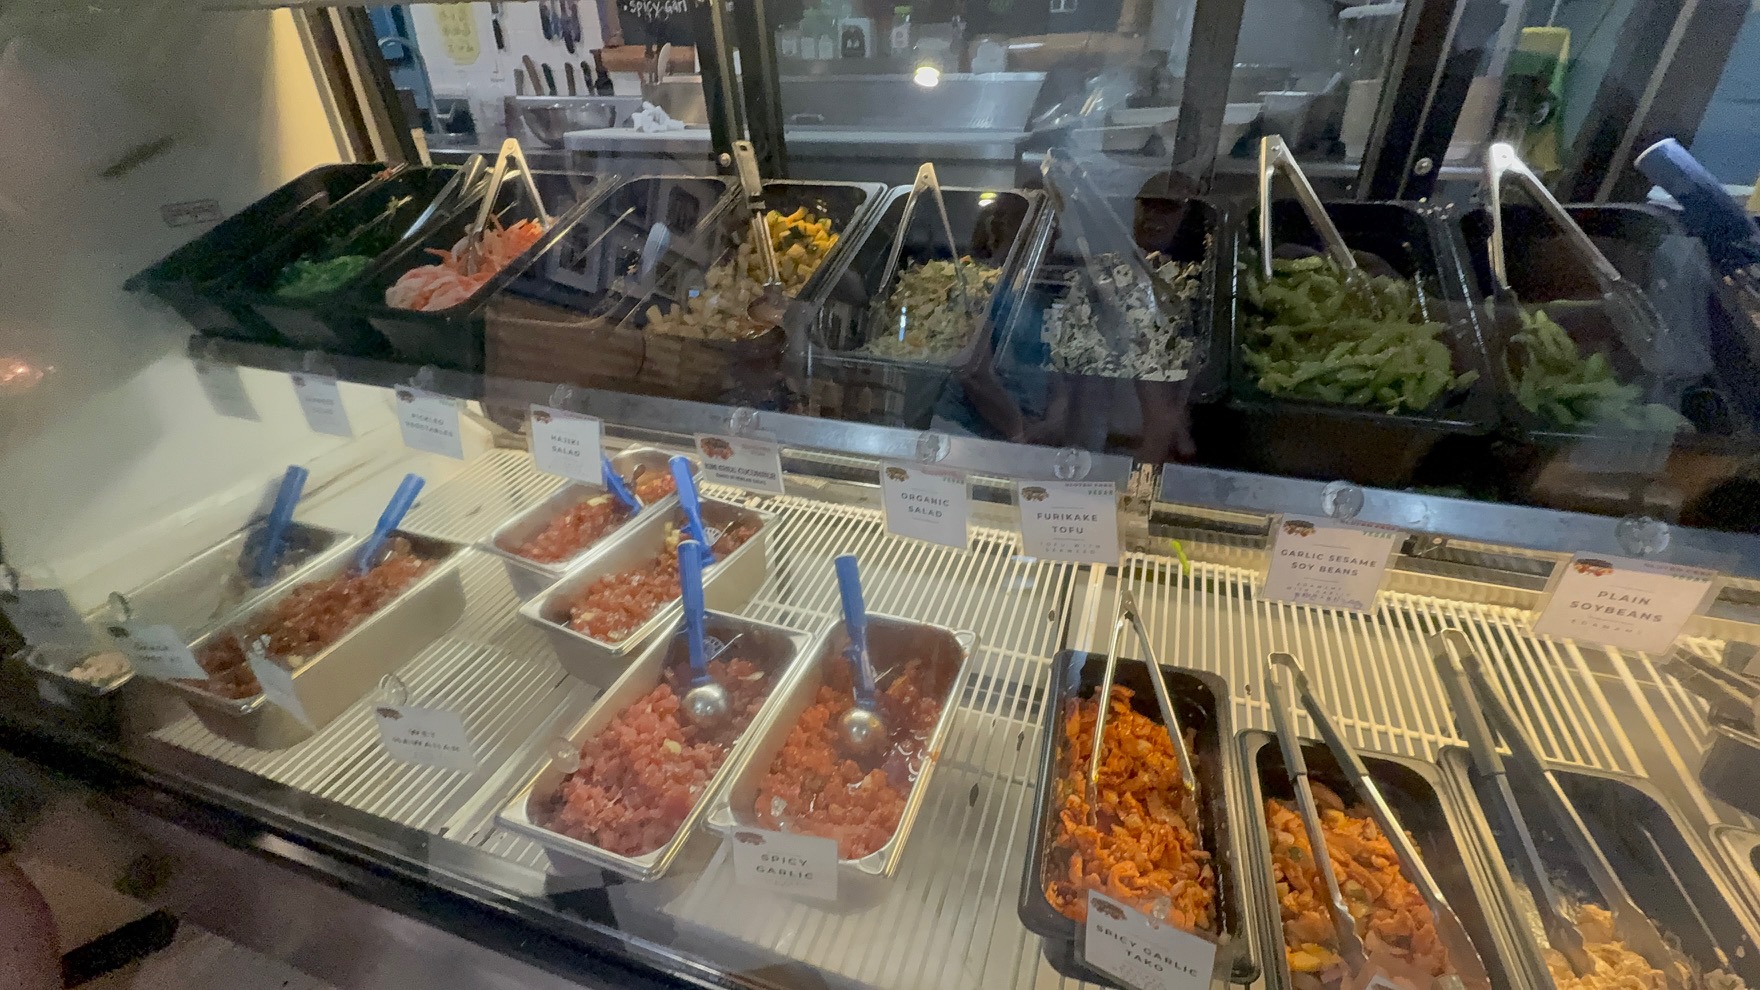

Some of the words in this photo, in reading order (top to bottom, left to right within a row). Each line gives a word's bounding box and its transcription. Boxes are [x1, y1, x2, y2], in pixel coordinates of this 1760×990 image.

[552, 445, 580, 457] SALAD
[901, 492, 950, 507] ORGANIC
[908, 505, 943, 518] SALAD
[1037, 512, 1098, 522] FURIKAKE
[1051, 525, 1084, 534] TOFU
[1280, 549, 1324, 561] GARLIC
[1328, 554, 1377, 568] SESAME
[1290, 561, 1315, 571] SOY
[1318, 565, 1359, 576] BEANS
[1597, 590, 1651, 606] PLAIN
[1569, 600, 1663, 623] SOYBEANS
[761, 854, 808, 866] SPICY
[756, 865, 814, 880] GARLIC
[1096, 924, 1137, 948] SPICY
[1143, 947, 1199, 978] GARLIC
[1126, 948, 1164, 972] TAKO
